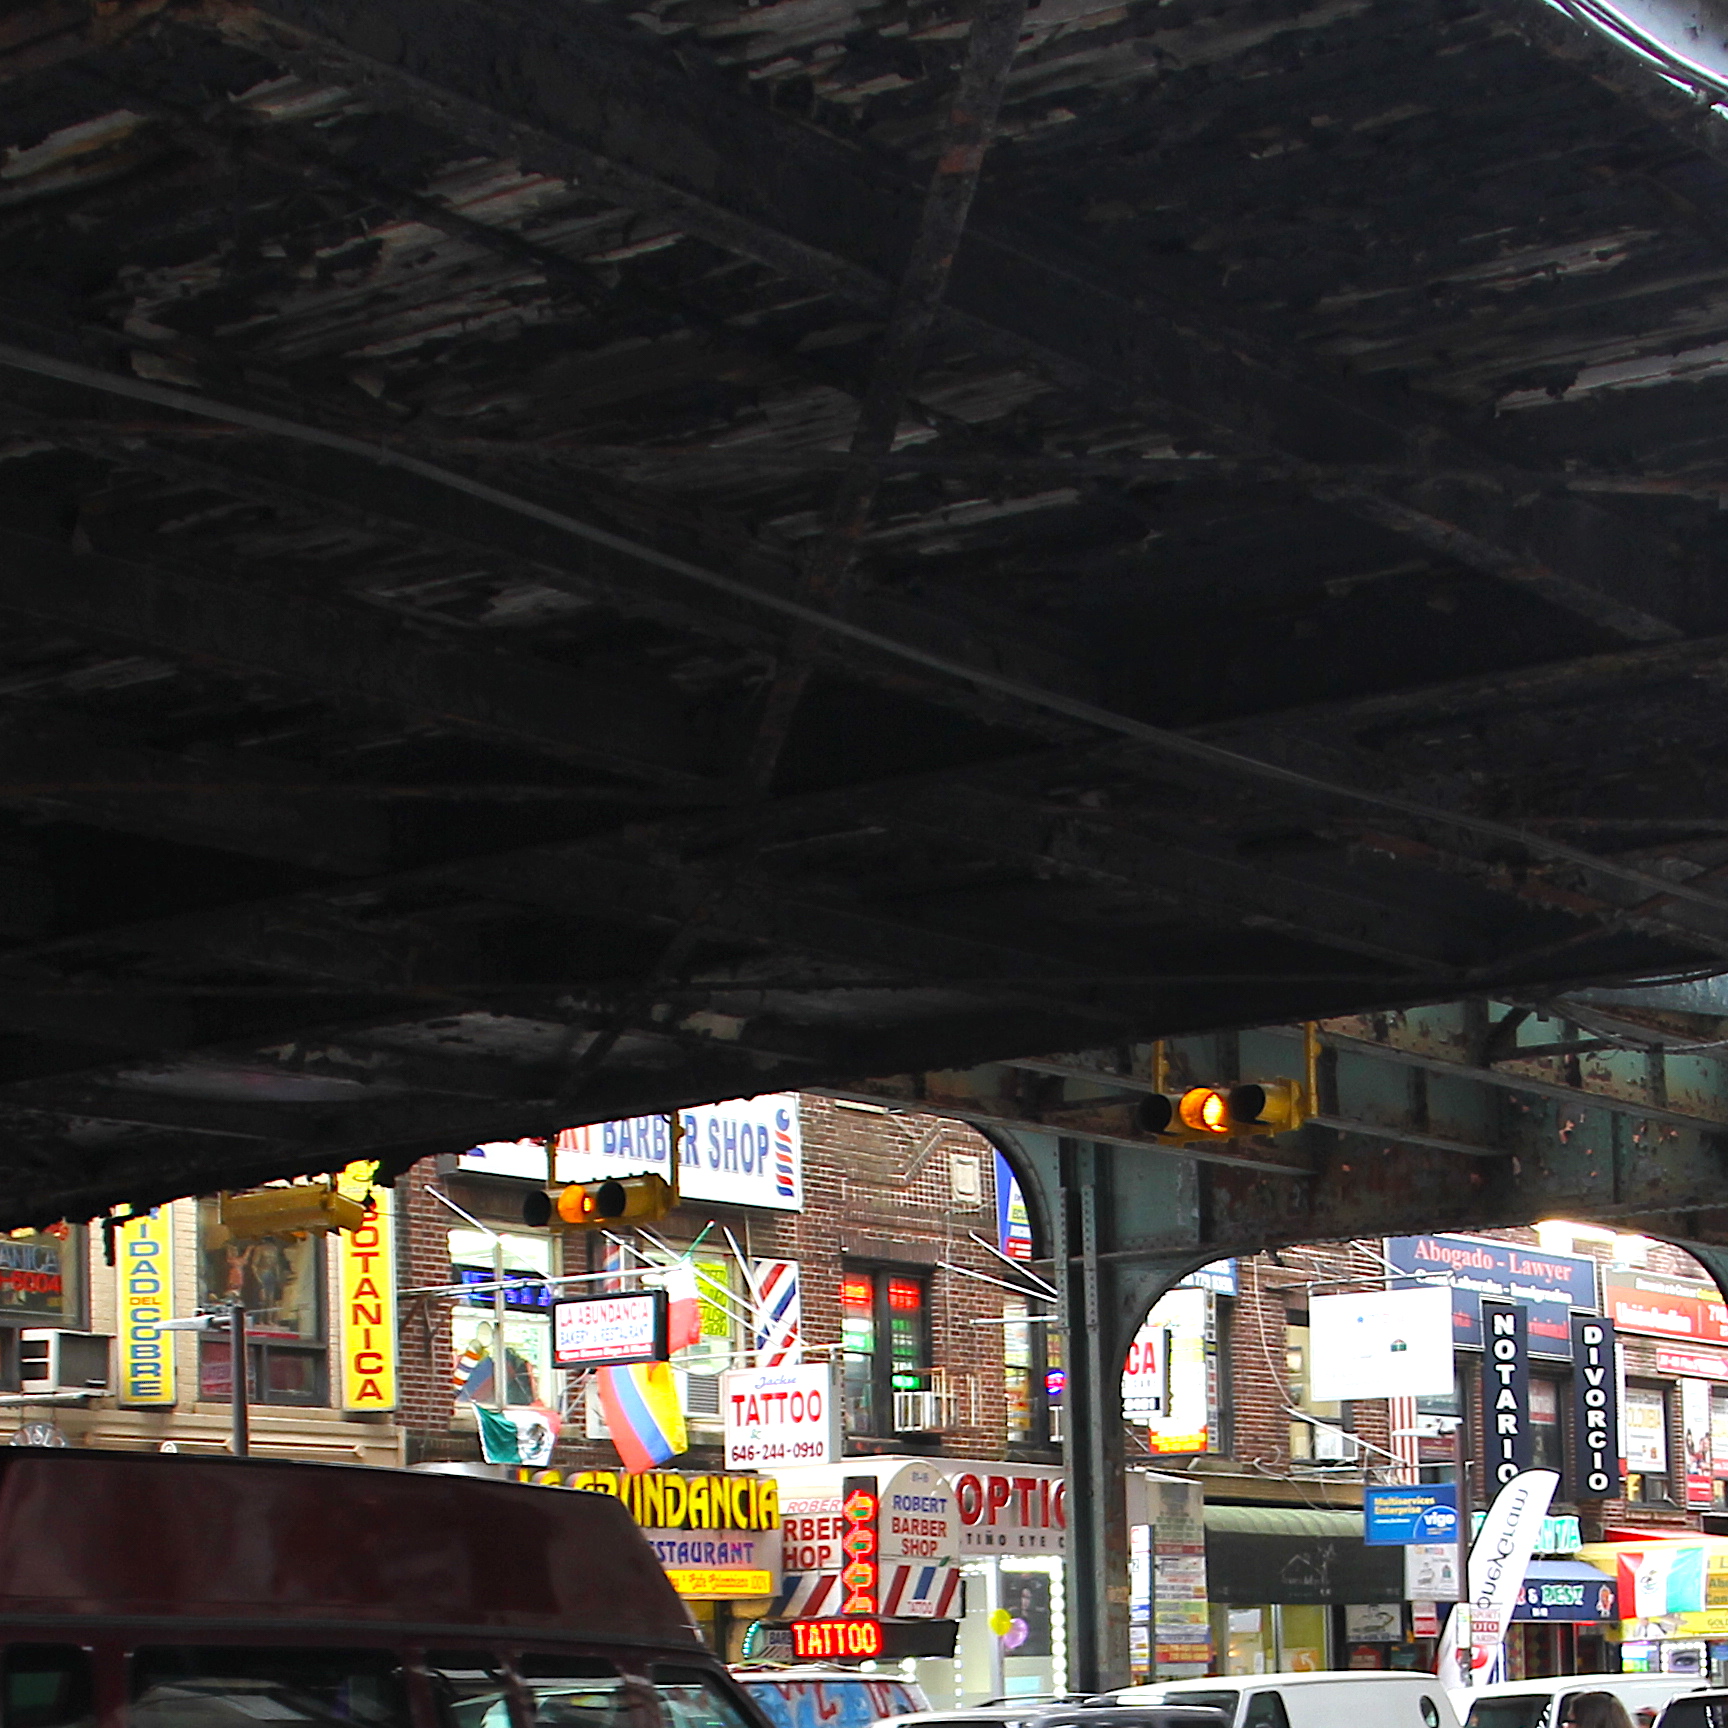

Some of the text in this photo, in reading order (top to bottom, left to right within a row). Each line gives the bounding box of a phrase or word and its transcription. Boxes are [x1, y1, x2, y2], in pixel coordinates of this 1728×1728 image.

[603, 1111, 769, 1176] BARBR SHOP
[129, 1210, 160, 1294] IDAD
[1414, 1239, 1494, 1271] Abogado
[1508, 1252, 1573, 1284] Lawyer
[129, 1296, 161, 1306] DEL
[130, 1307, 162, 1397] COBRE
[731, 1389, 822, 1427] TATTOO
[1493, 1313, 1519, 1485] NOTARIO
[1582, 1324, 1609, 1491] DIVORCIO
[731, 1441, 823, 1462] 646-244-0910
[893, 1494, 947, 1514] ROBERT
[783, 1516, 843, 1541] RBER
[892, 1516, 947, 1539] BARBER
[1423, 1511, 1456, 1528] vigo
[651, 1539, 755, 1566] STAURANT
[783, 1545, 831, 1570] HOP
[901, 1539, 939, 1557] SHOP
[906, 1600, 933, 1615] TATTOO
[793, 1621, 879, 1656] TATTOO
